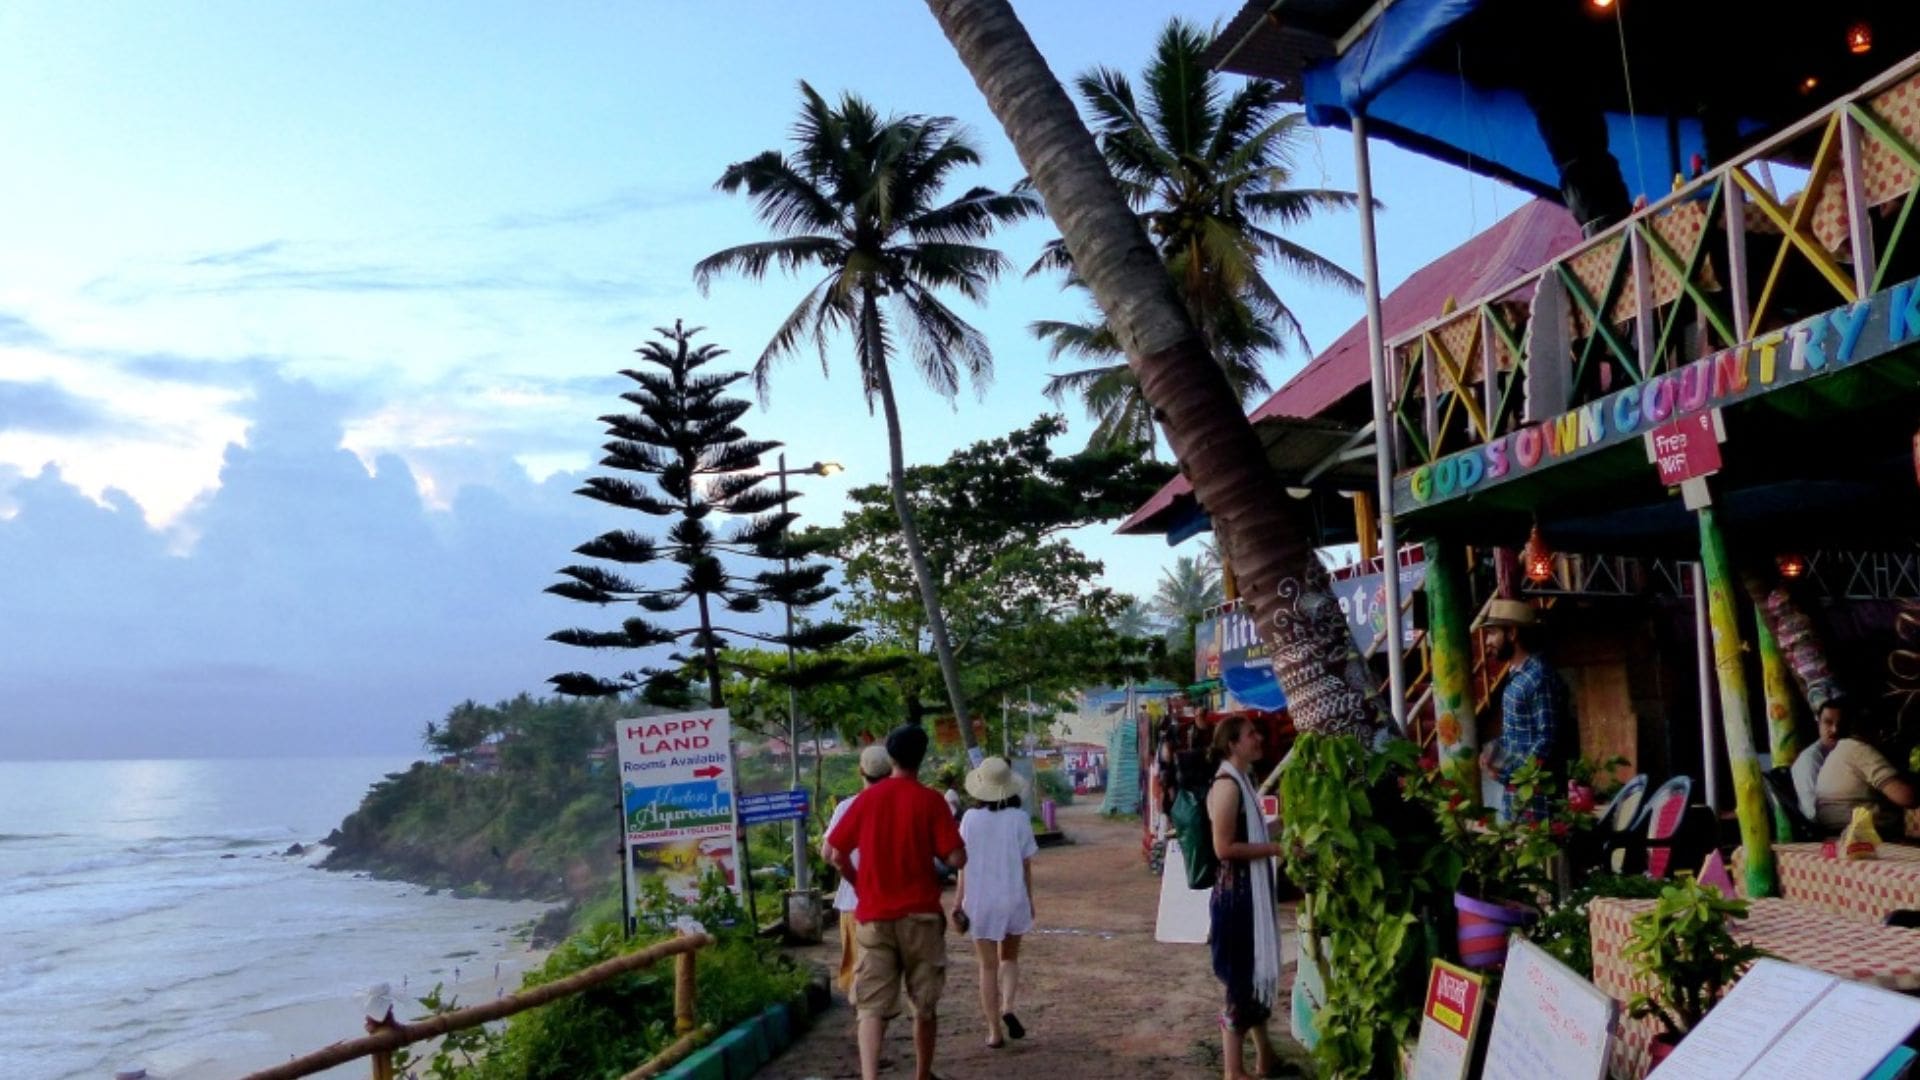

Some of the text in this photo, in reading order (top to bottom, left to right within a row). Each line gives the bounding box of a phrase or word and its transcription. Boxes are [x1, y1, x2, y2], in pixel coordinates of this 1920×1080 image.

[1514, 400, 1605, 469] OWN
[1613, 301, 1871, 434] COUNTRY
[1656, 433, 1687, 454] Free
[627, 718, 715, 740] HAPPY
[639, 736, 710, 755] LAND
[624, 752, 727, 772] Rooms Available
[706, 823, 732, 833] CENTRE
